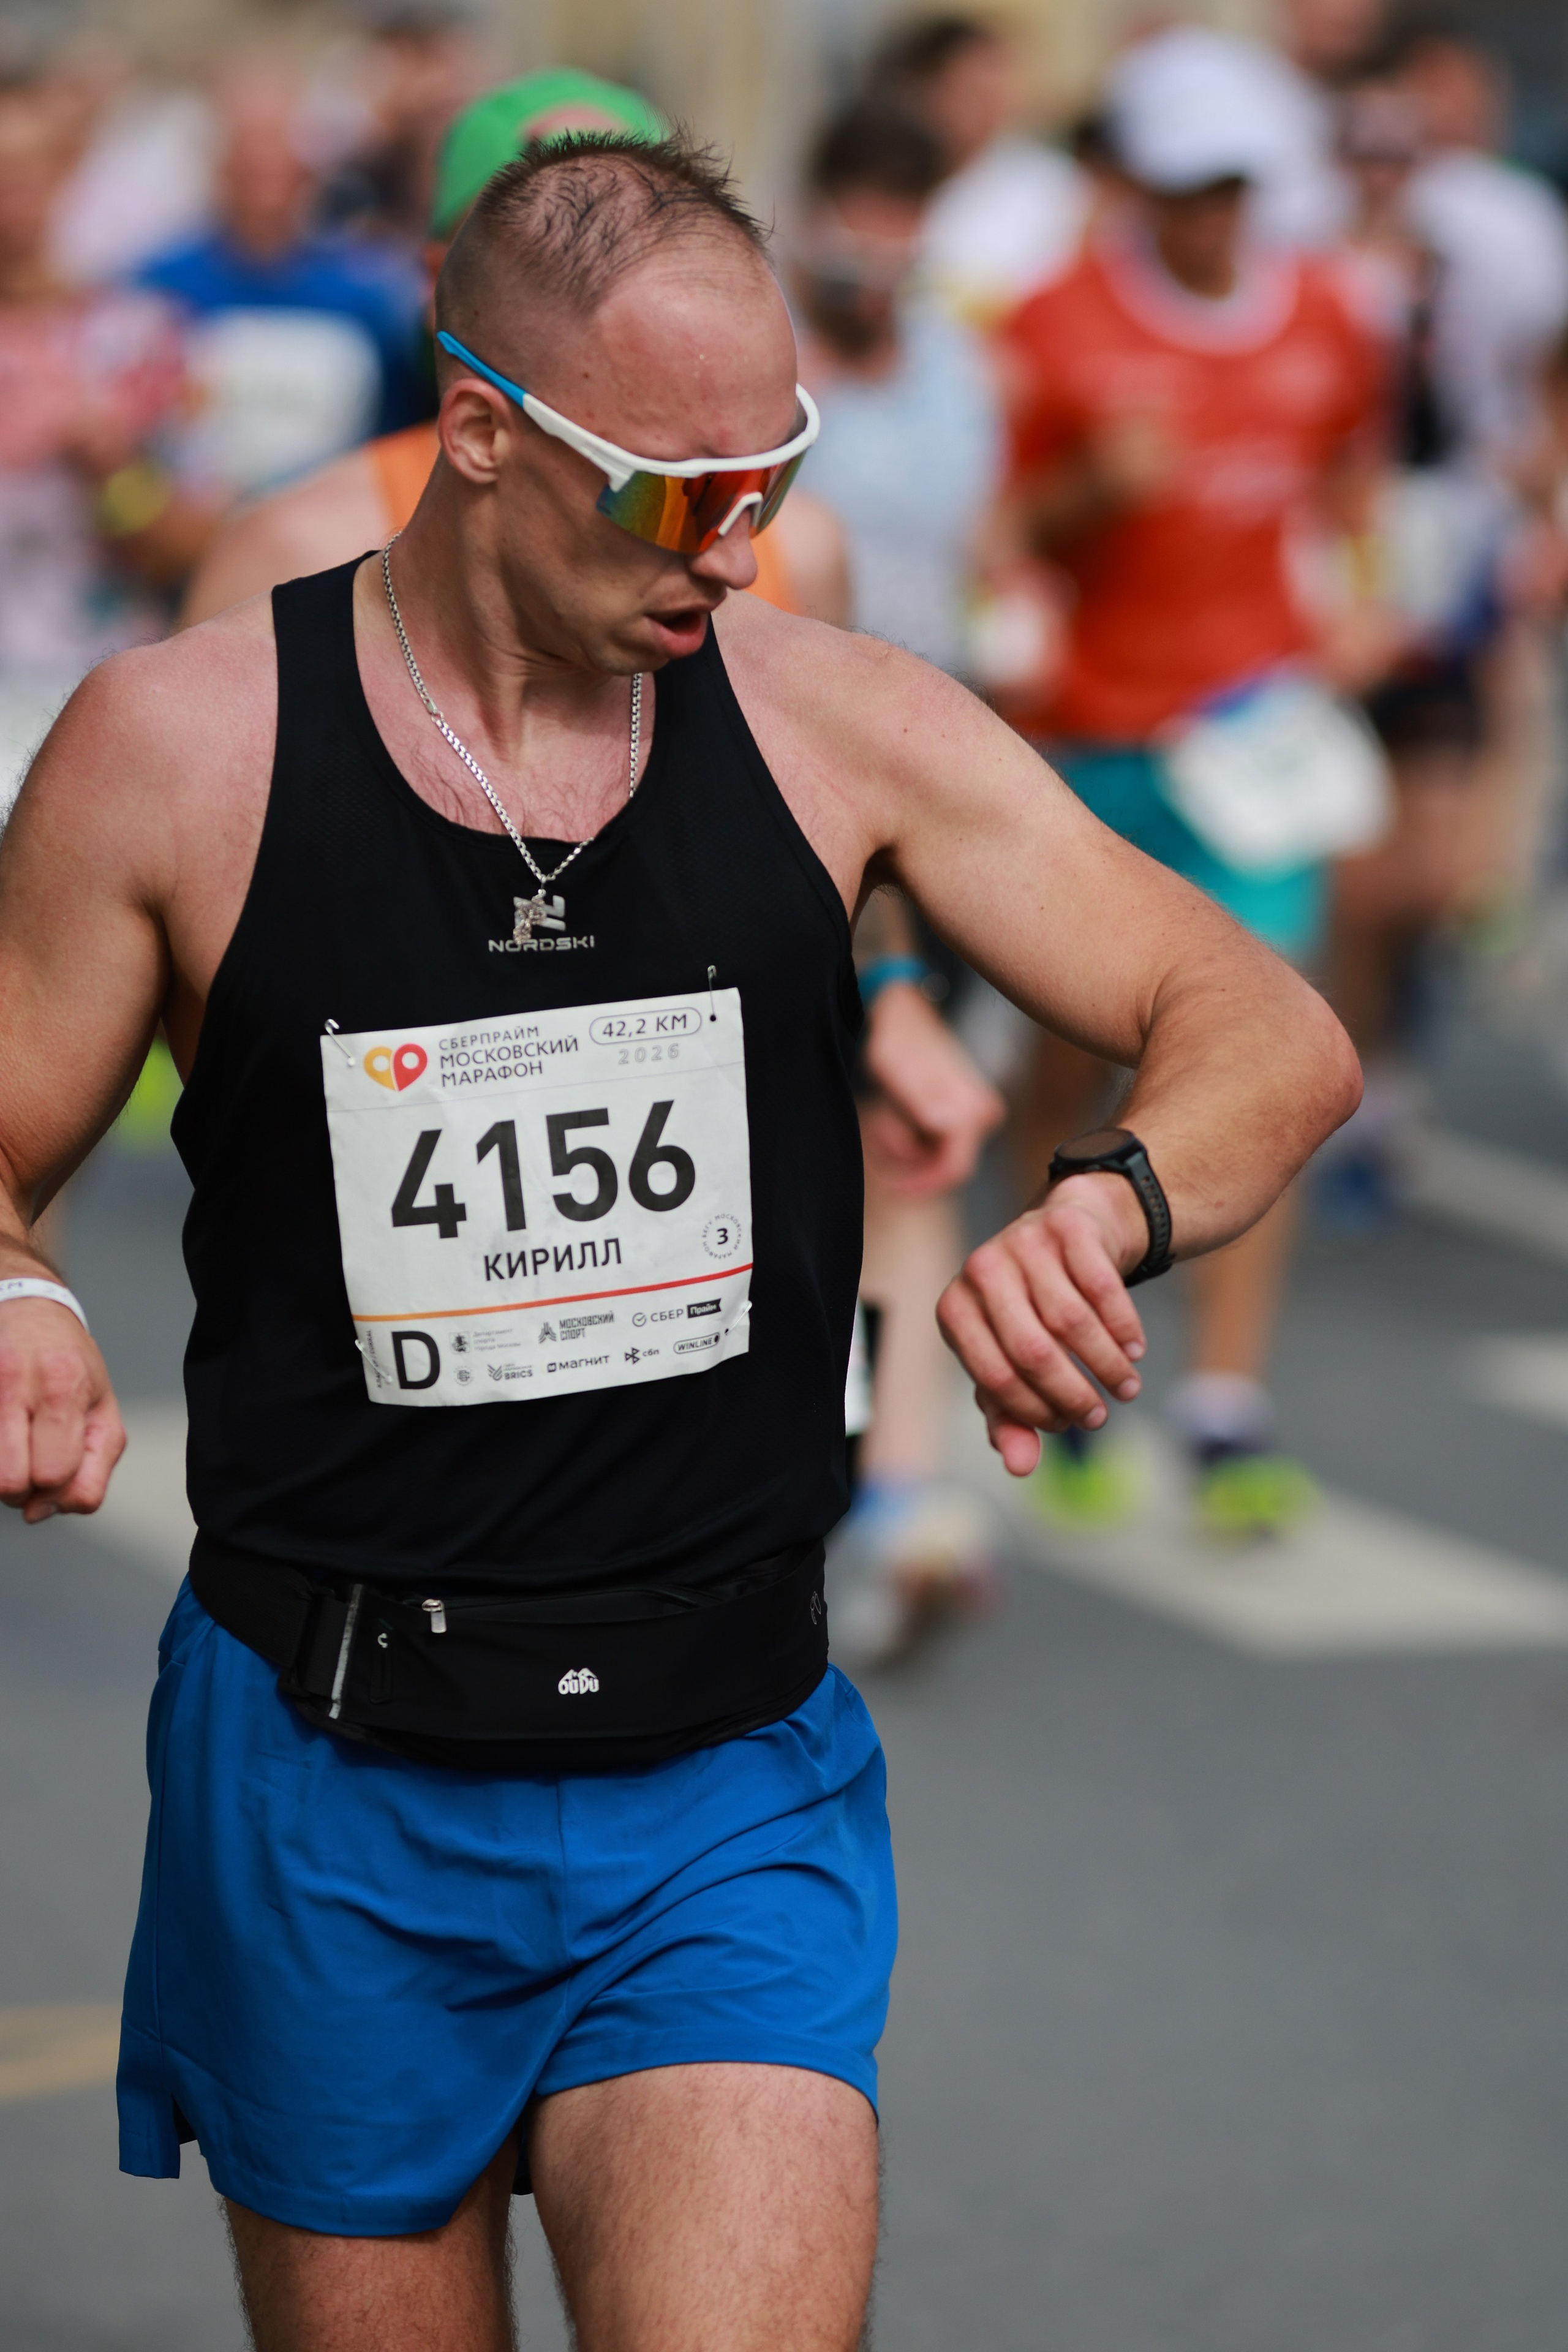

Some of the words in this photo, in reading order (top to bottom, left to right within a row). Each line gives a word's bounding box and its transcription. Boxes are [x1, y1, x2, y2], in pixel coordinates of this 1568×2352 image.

[488, 935, 595, 952] NORDSKI
[602, 1018, 646, 1038] 42,2
[656, 1013, 687, 1031] КМ
[439, 1025, 540, 1051] СБЕРПРАЙМ
[440, 1034, 579, 1069] МОСКОВСКИЙ
[617, 1042, 679, 1065] 2026
[441, 1060, 543, 1088] МАРАФОН
[391, 1100, 696, 1238] 4156
[717, 1227, 729, 1245] 3
[483, 1237, 622, 1281] КИРИЛЛ
[559, 1310, 614, 1330] МОСКОВСКИЙ
[650, 1308, 684, 1322] СБЕР
[690, 1303, 717, 1315] Прайм
[560, 1328, 586, 1341] СПОРТ
[677, 1337, 713, 1351] WINLINE
[391, 1330, 440, 1390] D
[559, 1355, 610, 1370] магнит
[643, 1348, 660, 1357] сбп
[505, 1370, 533, 1380] BRICS
